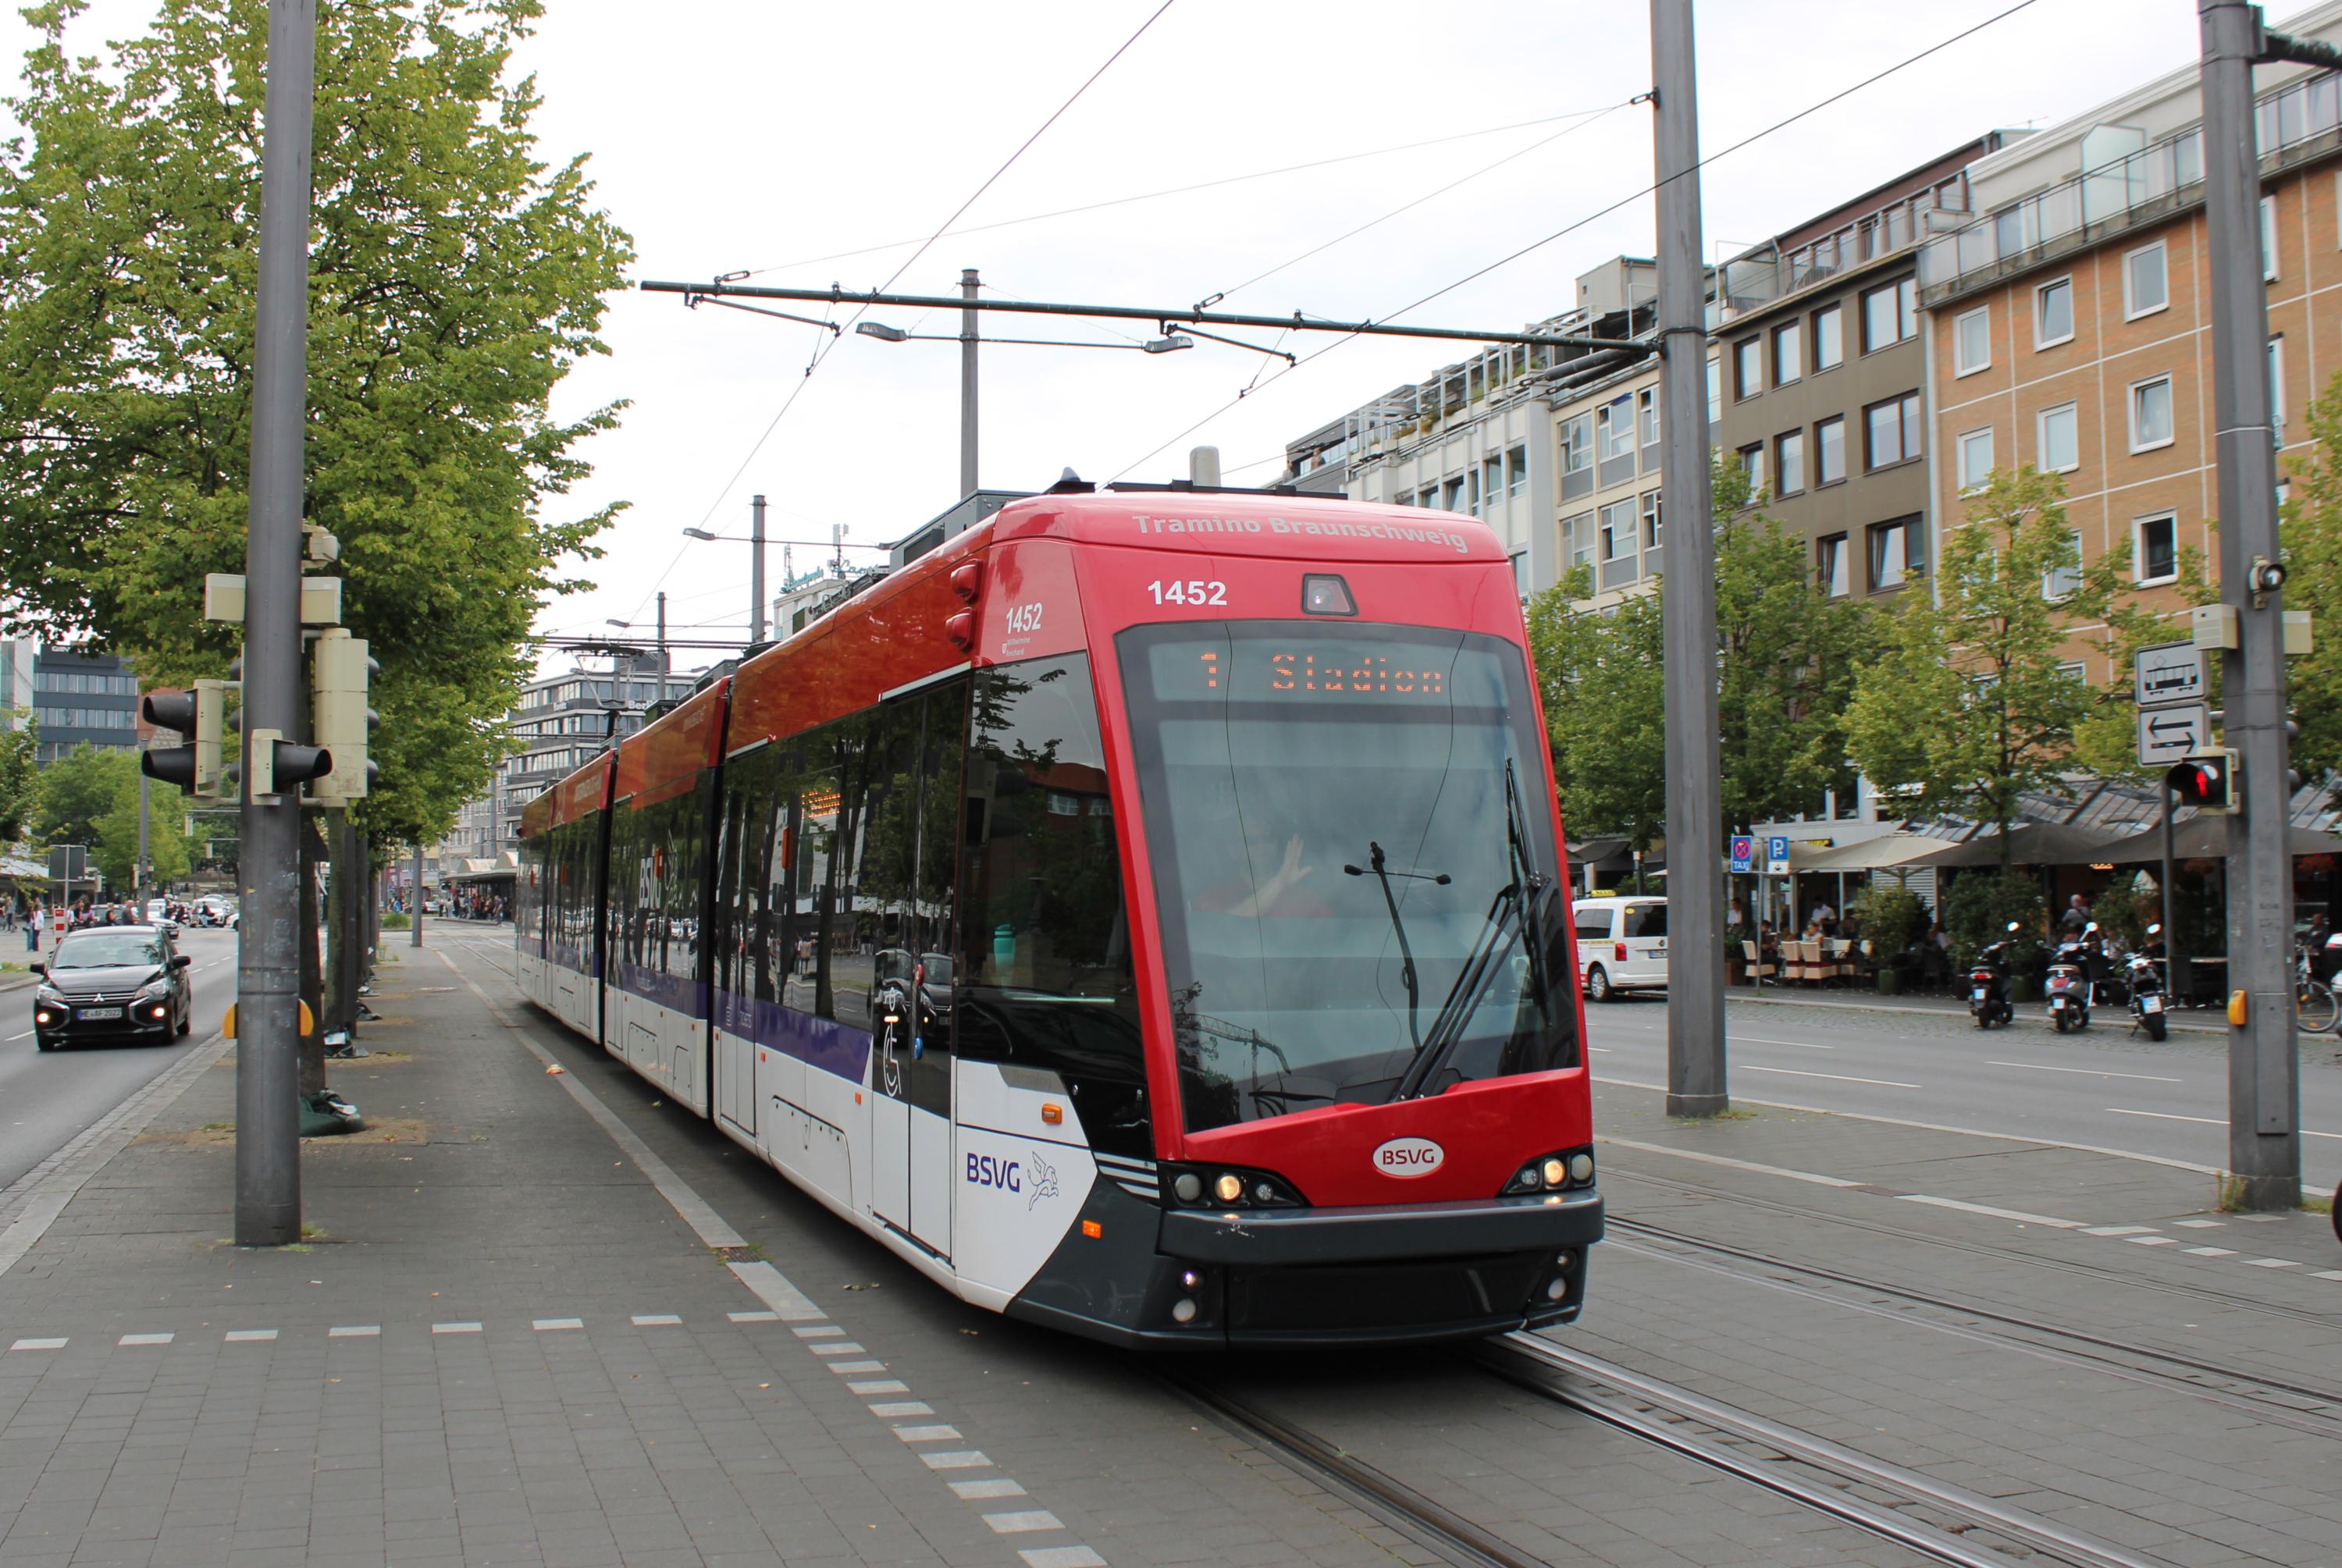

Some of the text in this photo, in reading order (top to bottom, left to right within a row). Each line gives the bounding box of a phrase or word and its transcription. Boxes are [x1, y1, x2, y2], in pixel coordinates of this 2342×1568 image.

[1132, 514, 1469, 554] Tramino Braunschweig
[1147, 580, 1228, 606] 1452
[1005, 602, 1043, 635] 1452
[1201, 652, 1442, 692] 1 Stadion
[1773, 838, 1785, 858] P
[966, 1151, 1020, 1193] BSVG
[1383, 1148, 1435, 1165] BSVG
